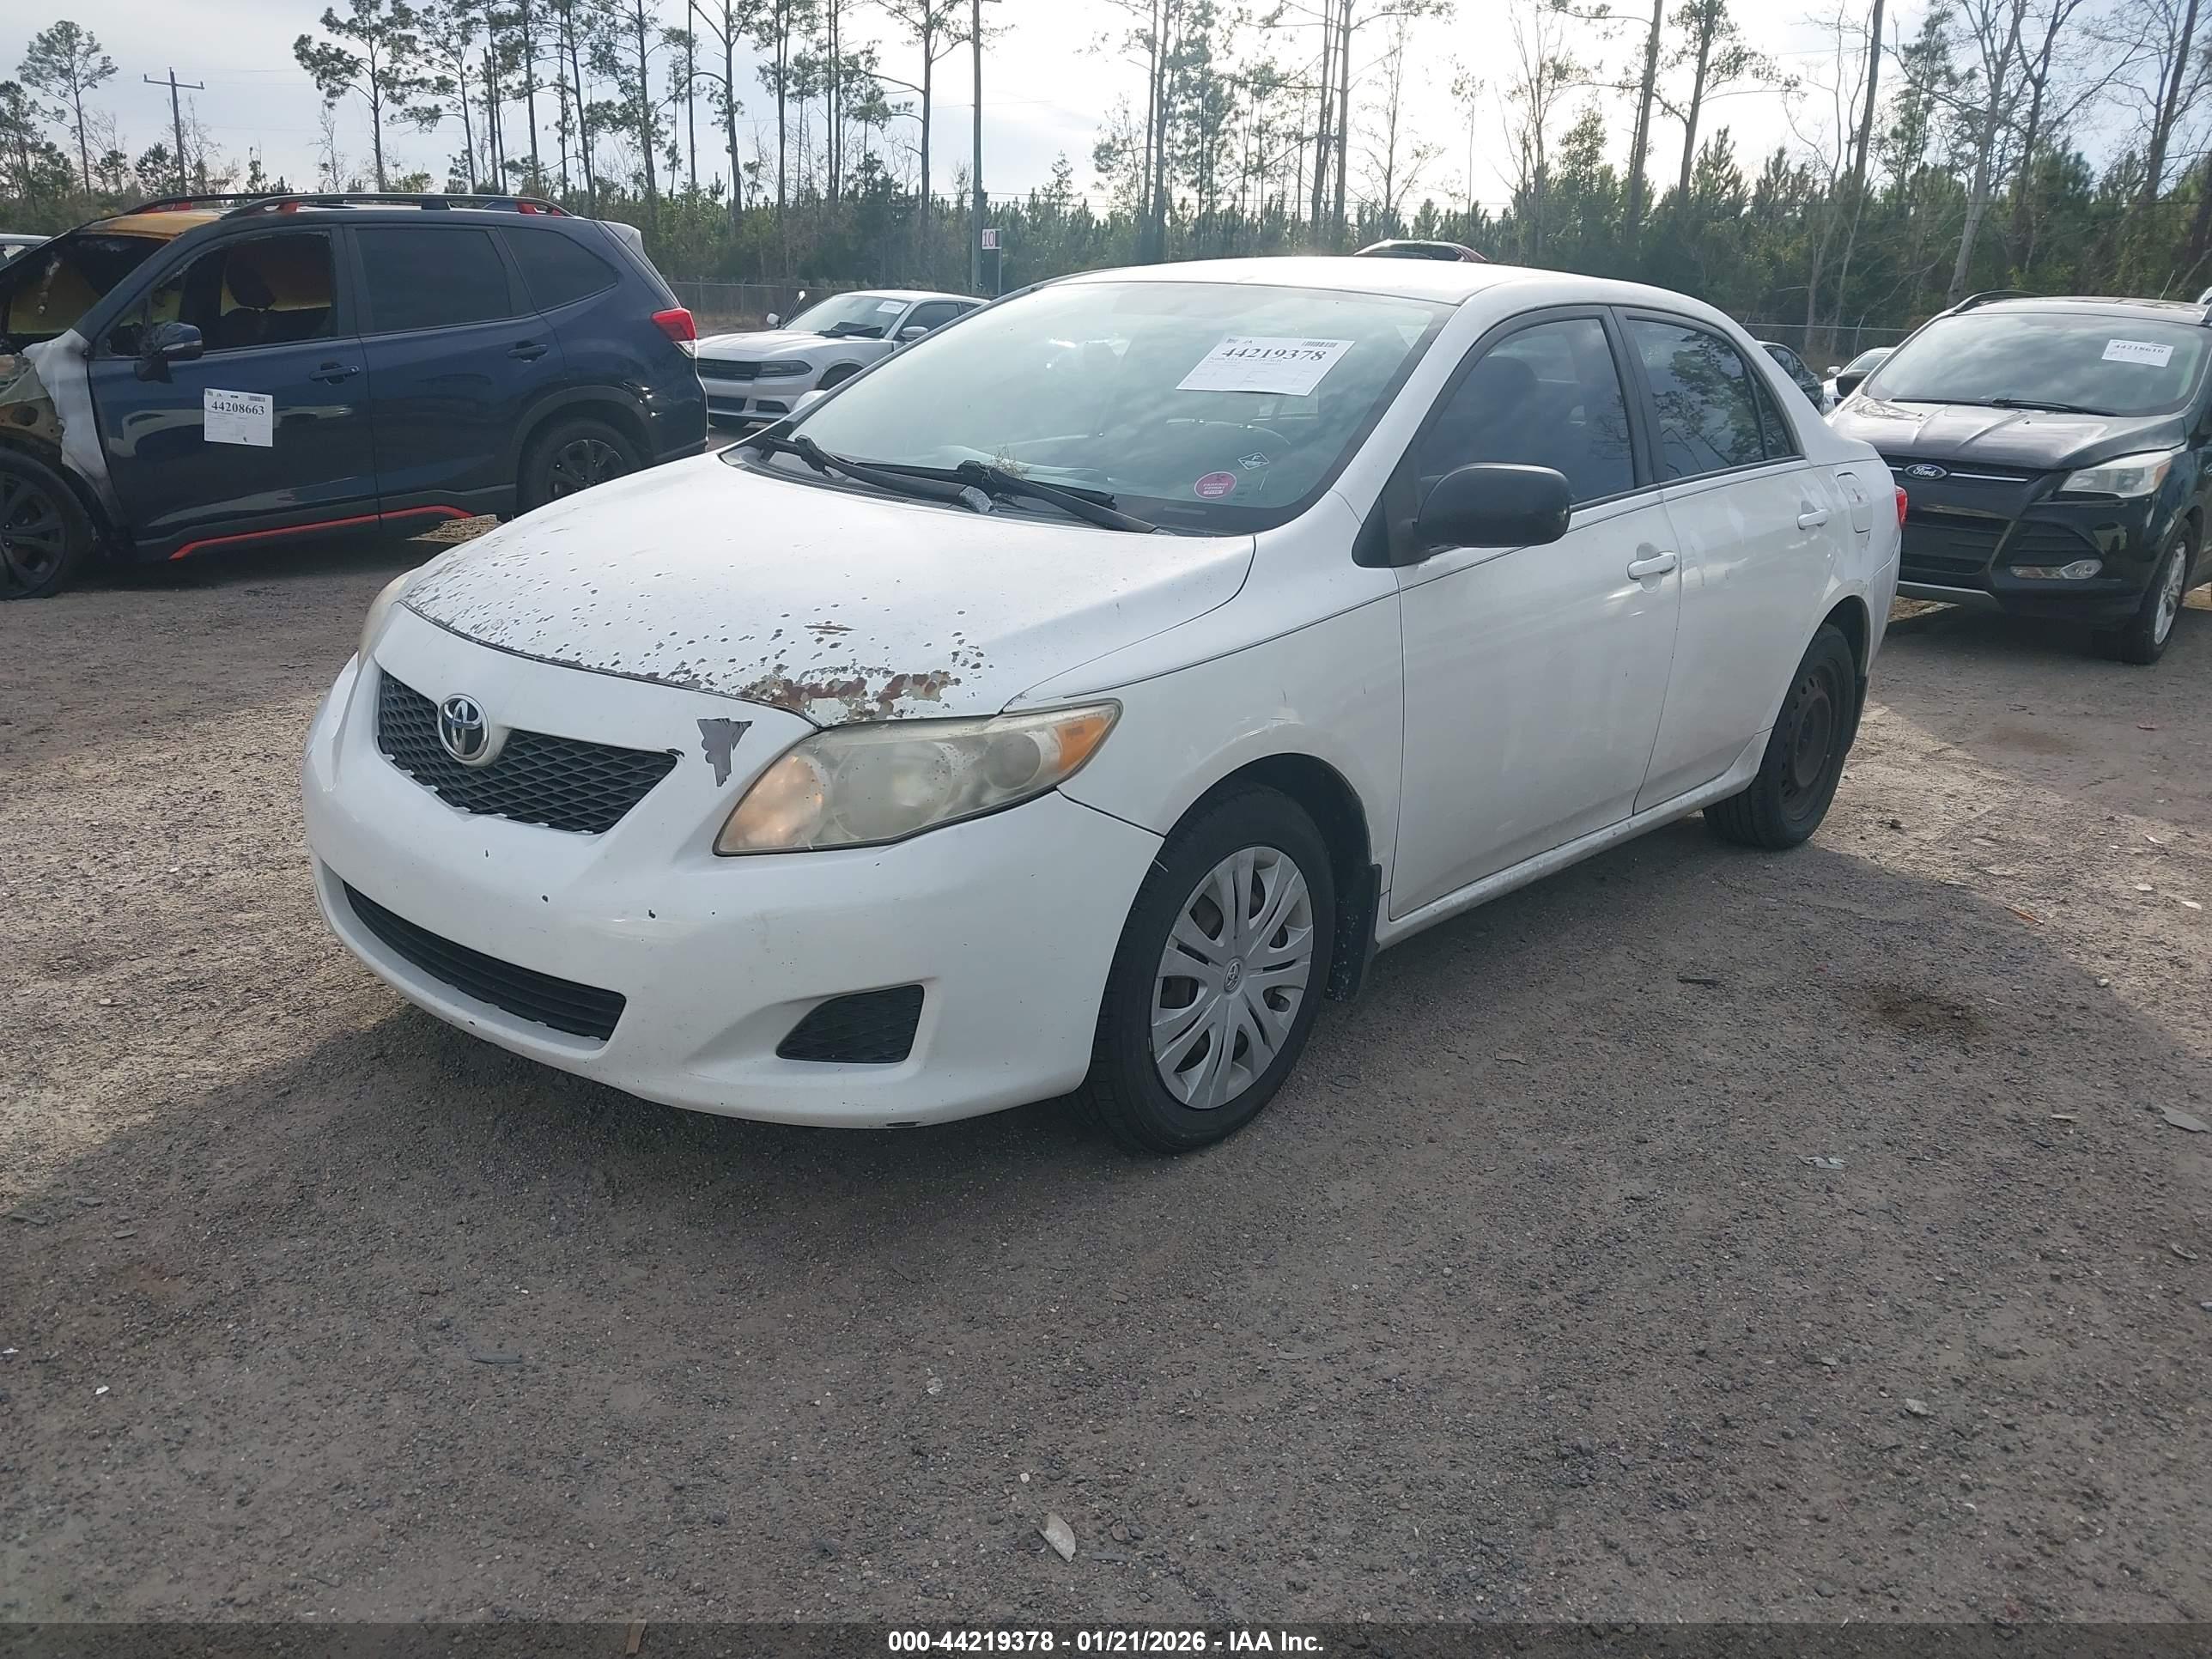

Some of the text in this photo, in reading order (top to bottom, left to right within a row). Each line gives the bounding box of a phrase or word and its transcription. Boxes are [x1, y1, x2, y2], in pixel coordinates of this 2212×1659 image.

[983, 232, 994, 246] 10
[1222, 347, 1328, 362] 44219378
[211, 400, 264, 416] 44208663
[1912, 465, 1937, 477] Ford
